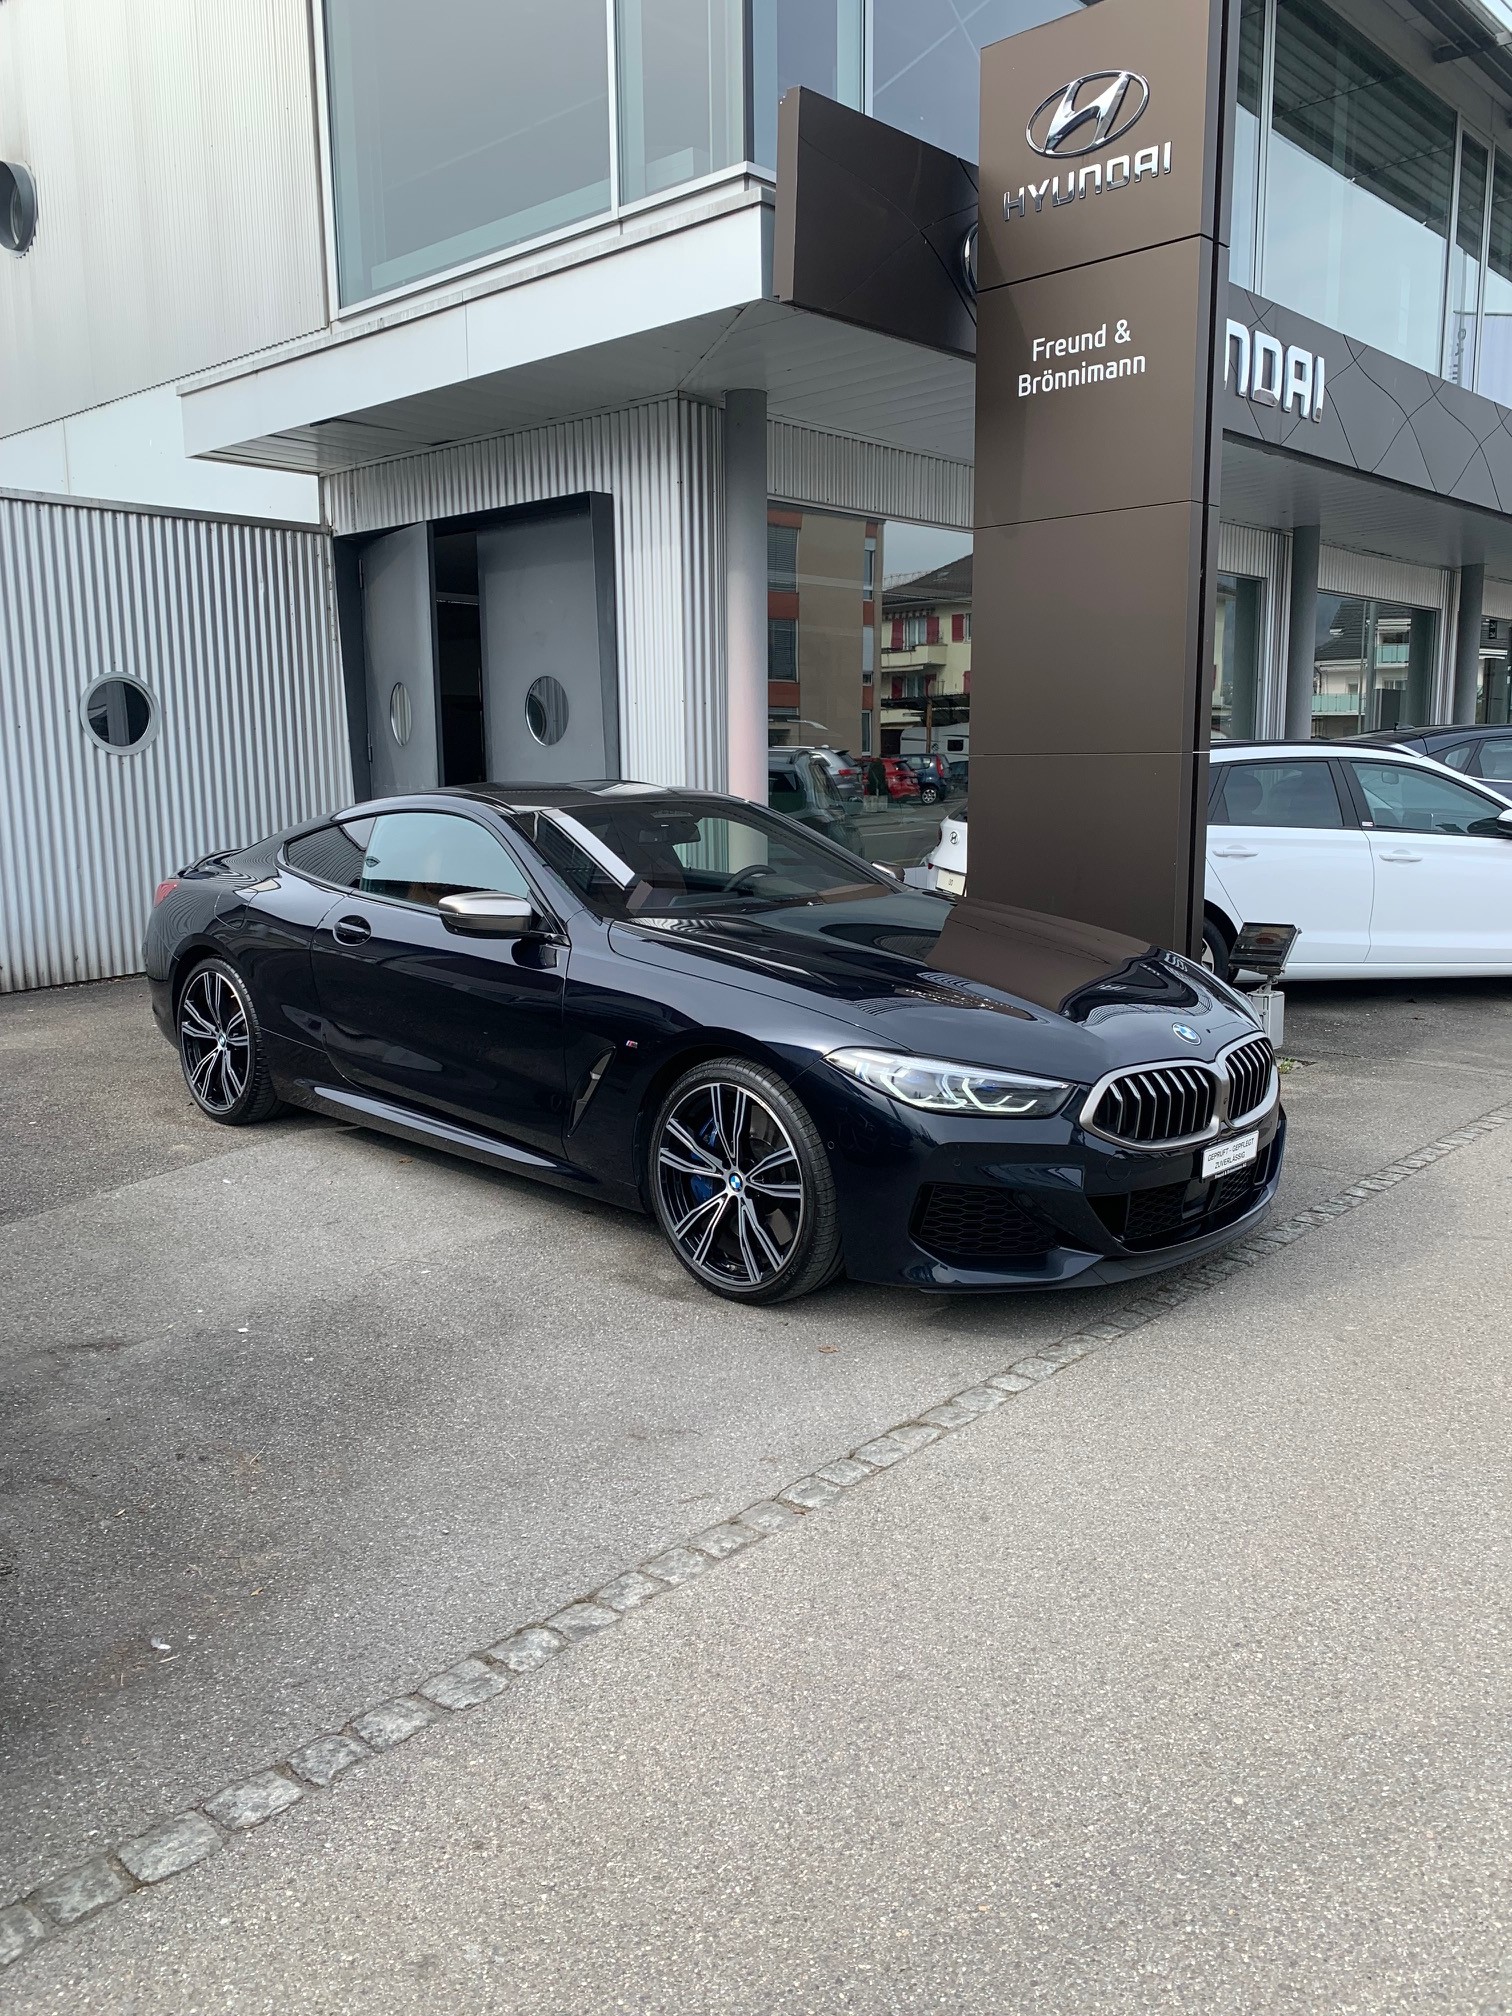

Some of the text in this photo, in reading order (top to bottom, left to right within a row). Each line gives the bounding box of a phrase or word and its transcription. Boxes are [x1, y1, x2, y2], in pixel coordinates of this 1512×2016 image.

[1002, 141, 1173, 221] HYUNDAI
[1032, 319, 1131, 361] Freund &
[1223, 317, 1325, 423] NDAI
[1018, 355, 1146, 397] Brönnimann
